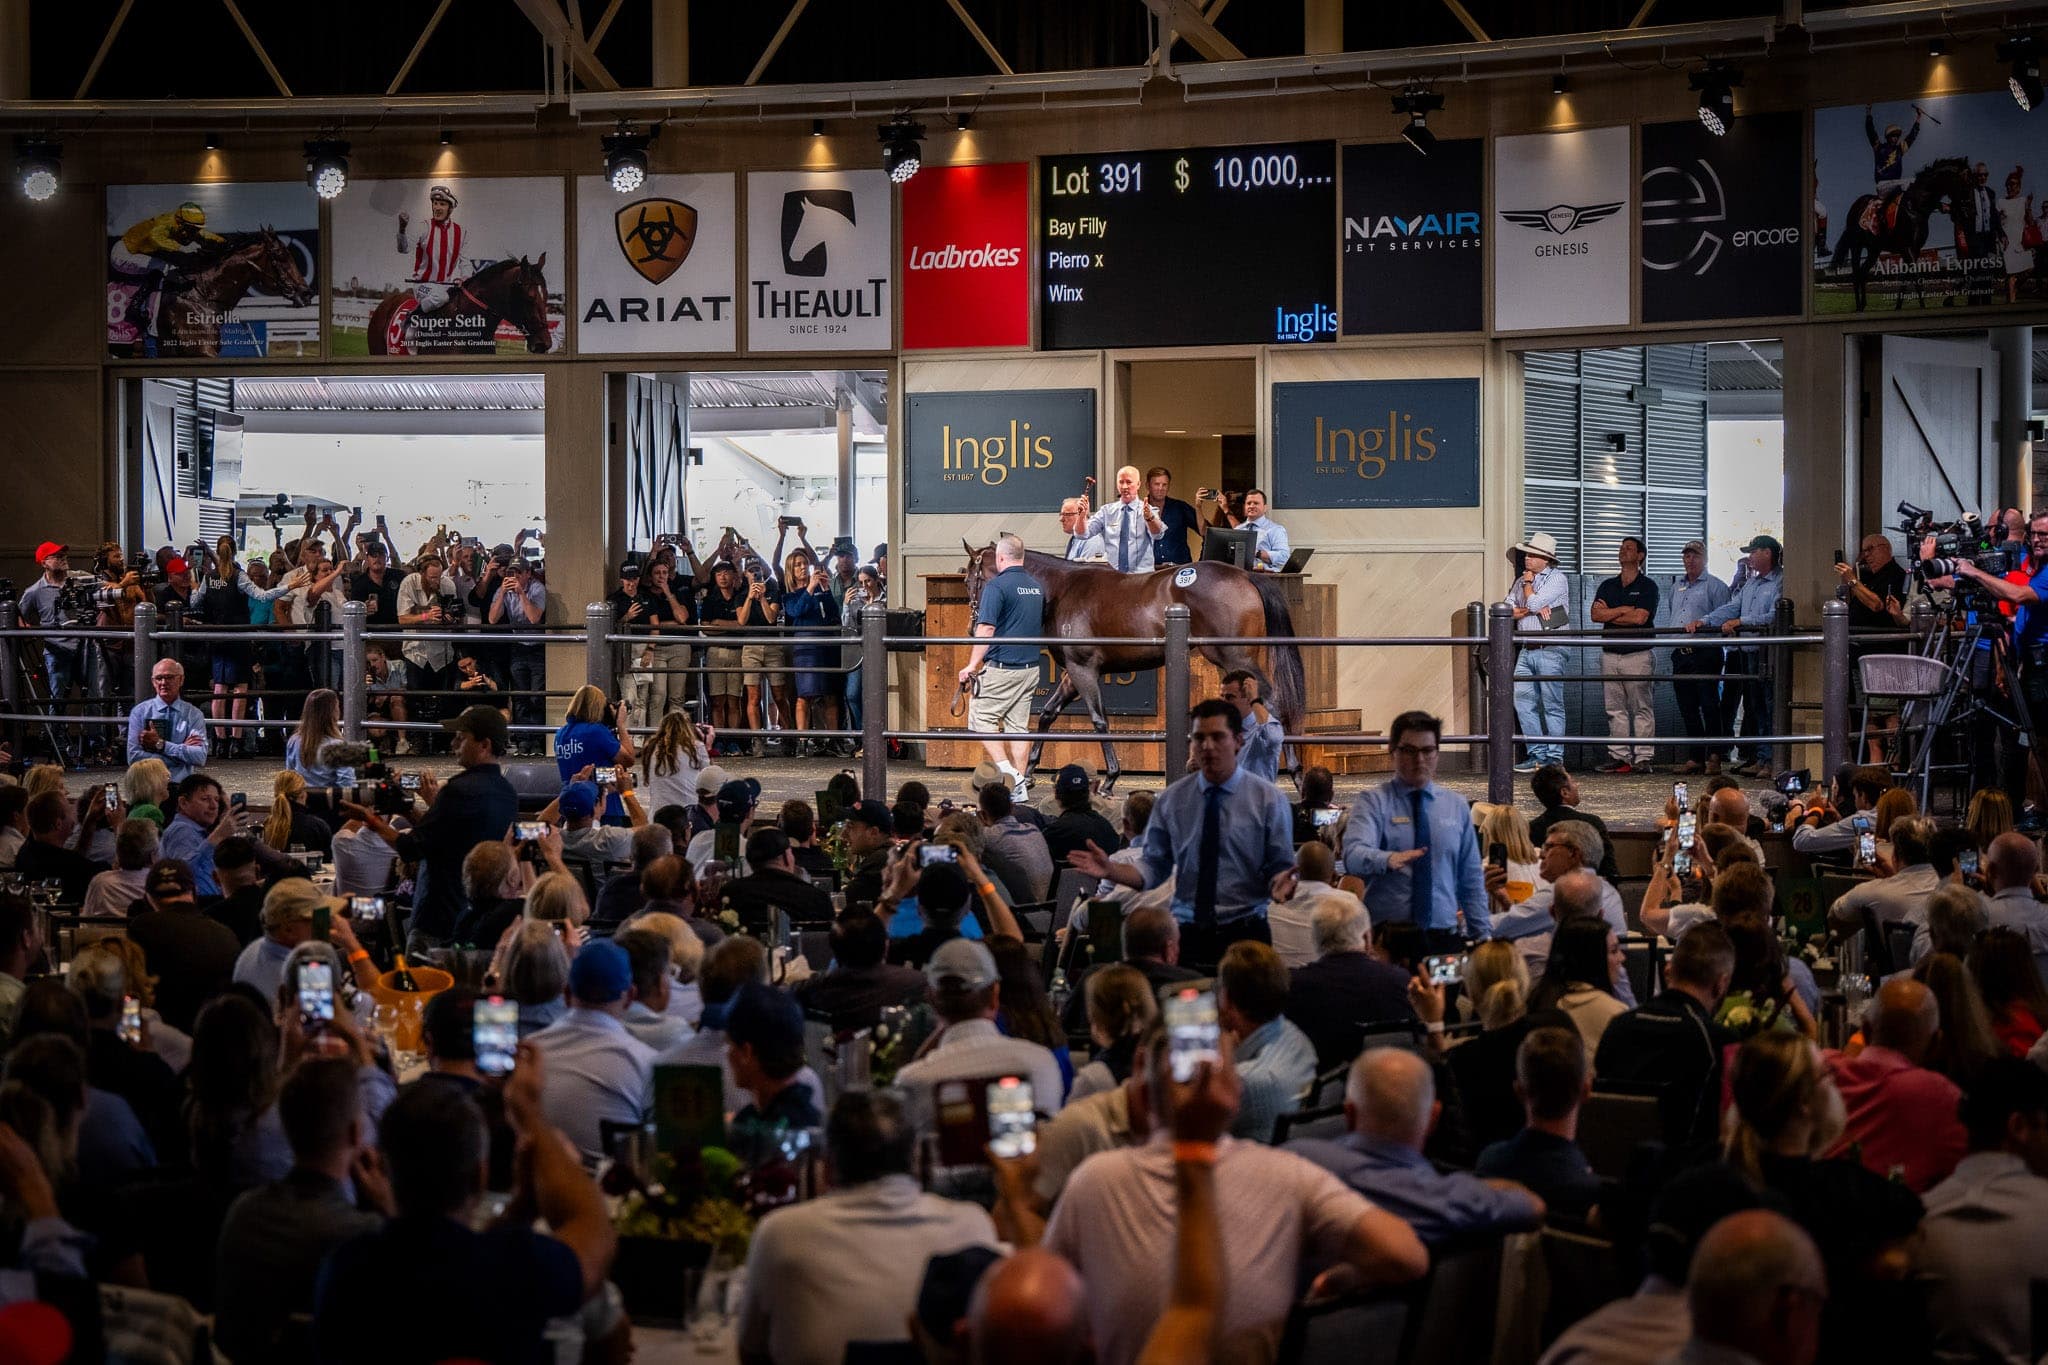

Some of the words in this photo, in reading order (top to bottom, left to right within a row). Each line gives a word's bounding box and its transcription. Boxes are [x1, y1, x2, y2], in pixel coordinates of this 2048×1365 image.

[1052, 165, 1090, 195] Lot
[1100, 162, 1141, 193] 391
[1175, 157, 1190, 193] $
[1345, 210, 1480, 240] NAVAIR
[1550, 212, 1573, 220] GENESIS
[1049, 218, 1076, 239] Bay
[1079, 216, 1107, 238] Filly
[1732, 227, 1800, 247] encore
[1345, 243, 1376, 253] JET
[1389, 239, 1481, 252] SERVICES
[1534, 242, 1589, 257] GENESIS
[909, 242, 1021, 270] Ladbrokes
[1049, 251, 1090, 269] Pierro
[1094, 254, 1104, 267] x
[1874, 257, 1941, 275] Alabama
[1946, 254, 2004, 275] Express
[752, 278, 887, 319] THEAULT
[1049, 284, 1083, 302] Winx
[186, 310, 241, 325] Estriella
[582, 296, 731, 323] ARIAT
[410, 314, 452, 331] Super
[455, 313, 486, 328] Seth
[789, 325, 819, 334] SINCE
[824, 324, 848, 334] 1924
[1277, 303, 1337, 342] Inglis
[416, 340, 432, 348] Inglis
[943, 419, 1054, 485] Inglis
[1315, 410, 1437, 479] Inglis
[943, 473, 956, 481] EST
[209, 576, 228, 590] Inglis
